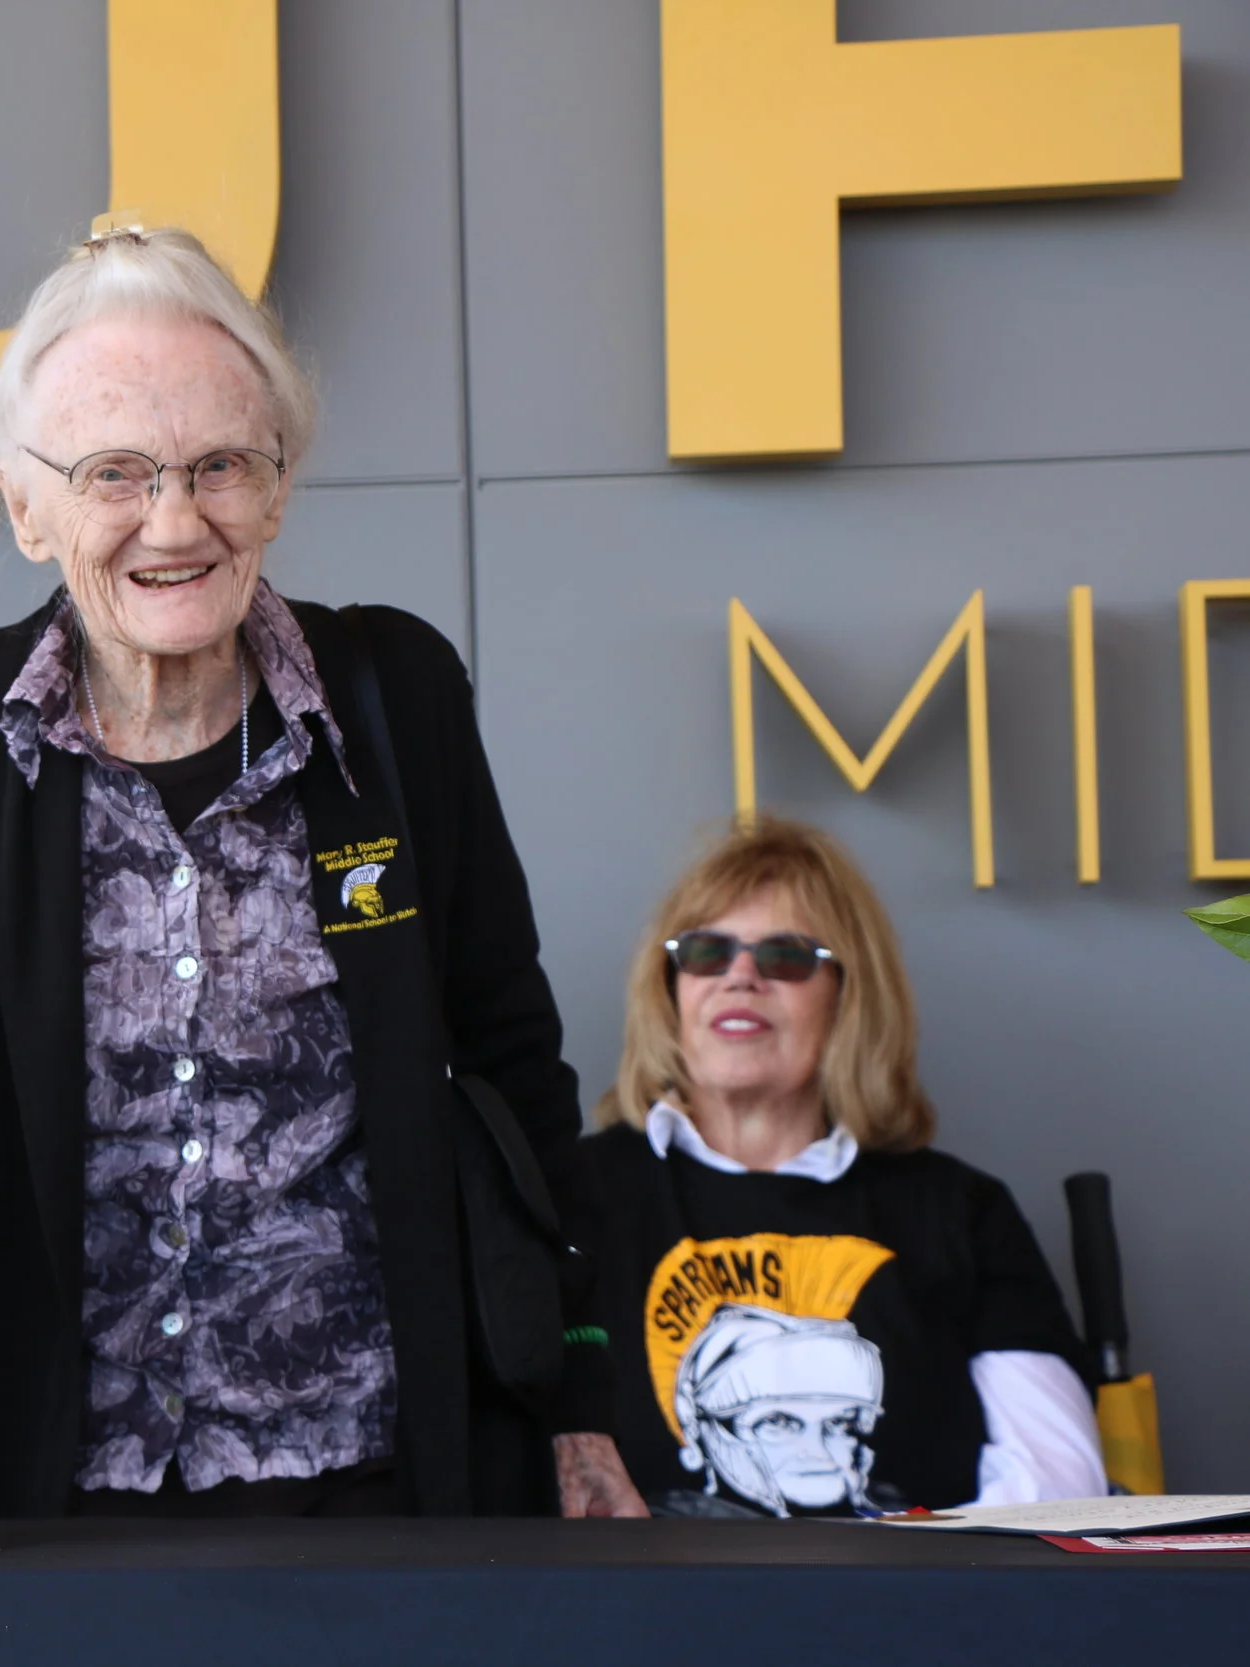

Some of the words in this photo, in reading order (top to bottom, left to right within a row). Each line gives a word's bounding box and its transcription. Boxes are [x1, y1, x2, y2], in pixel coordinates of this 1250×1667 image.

[325, 857, 362, 871] Middle
[362, 848, 394, 863] School
[654, 1250, 783, 1343] SPARTANS
